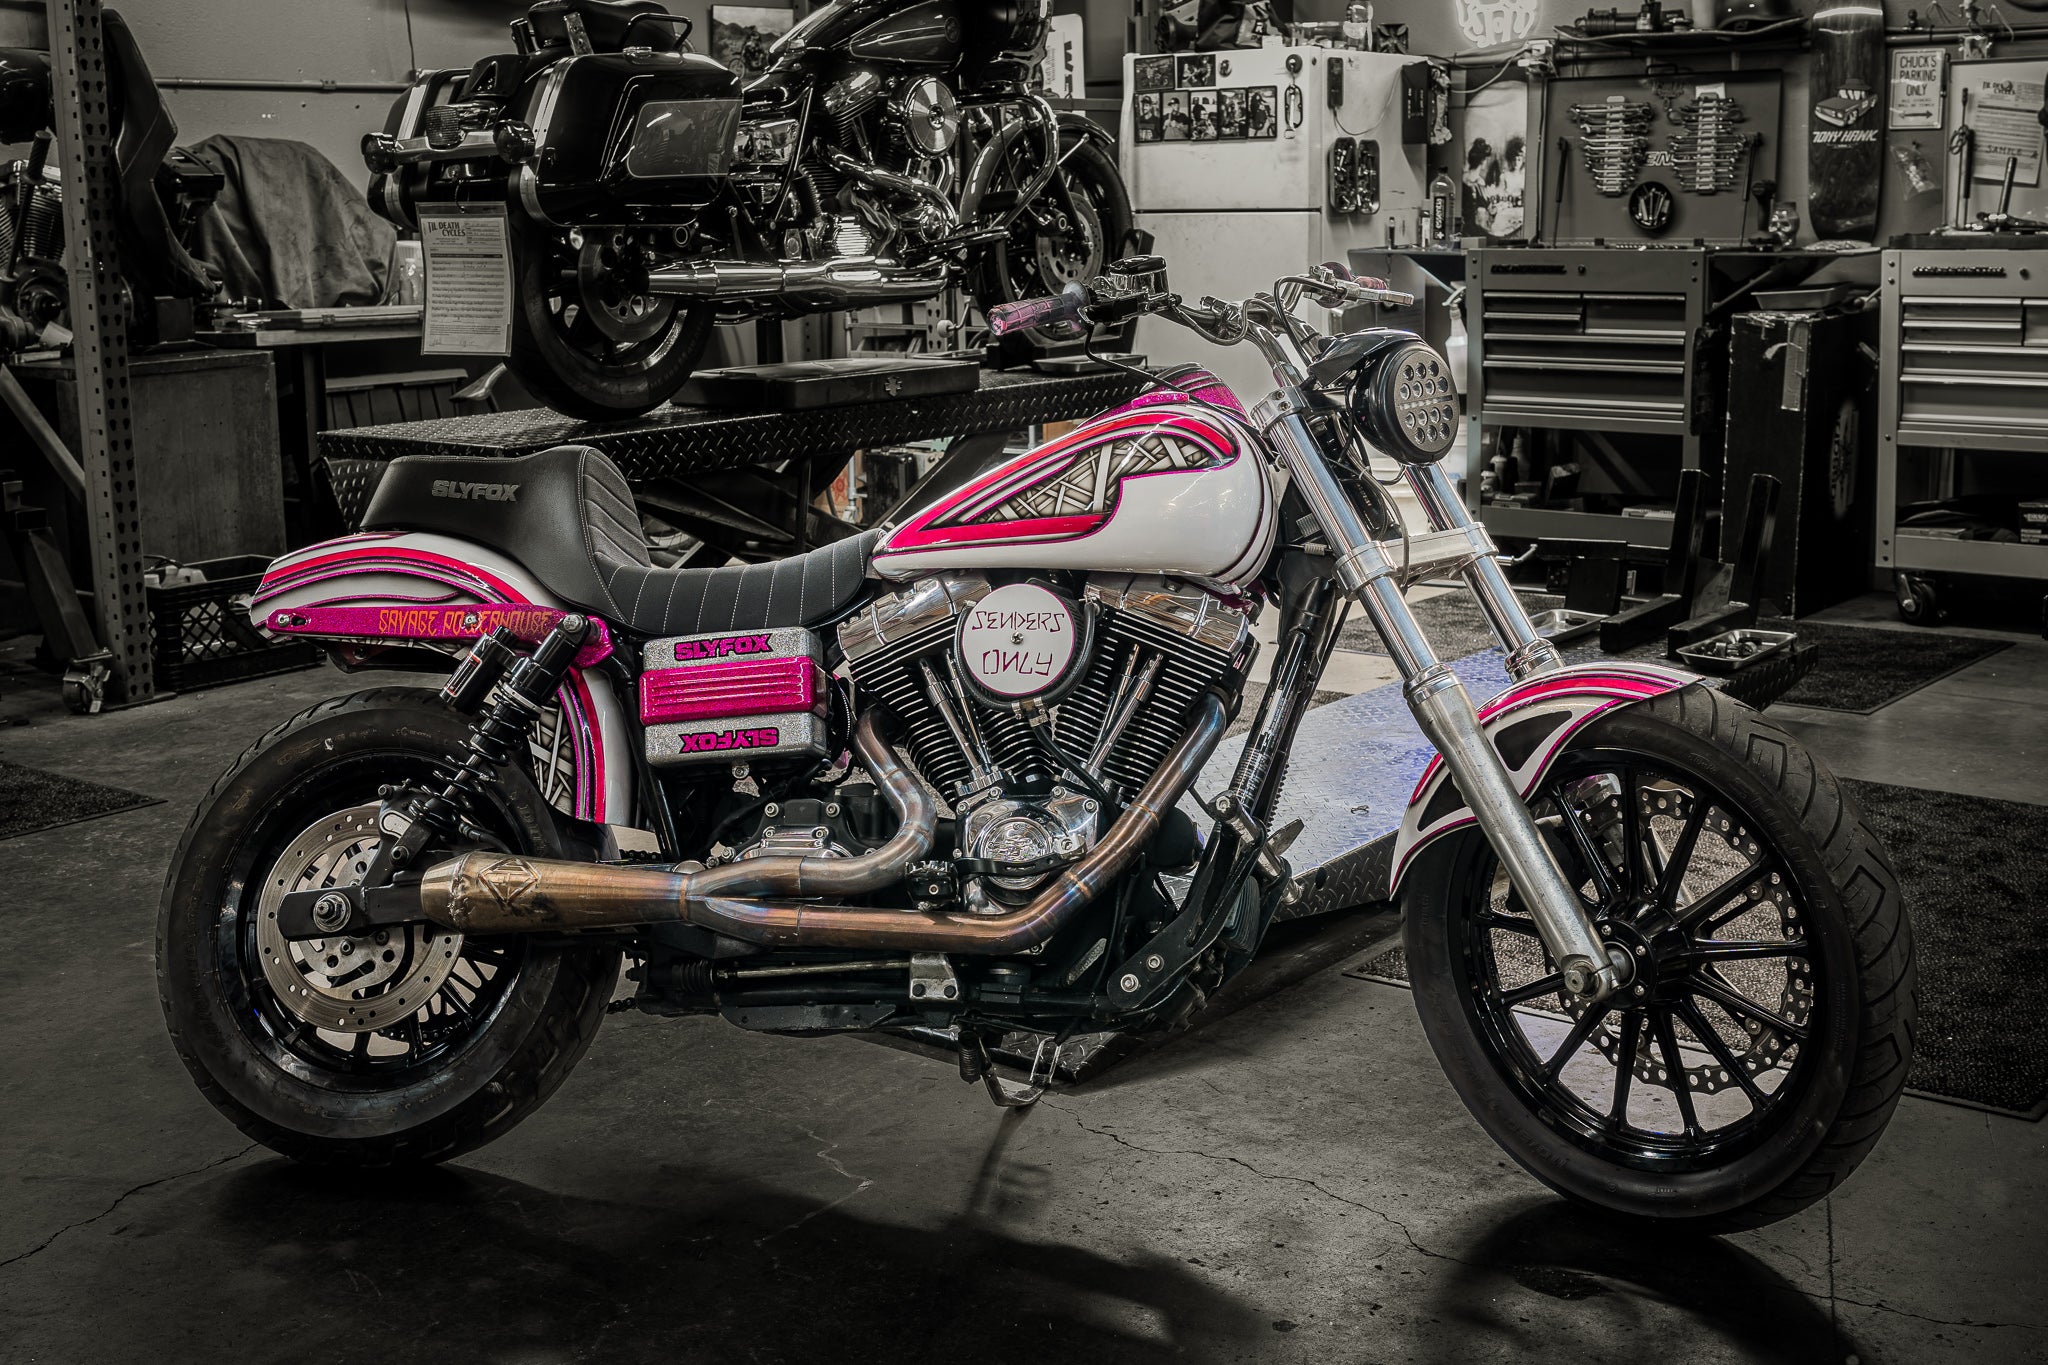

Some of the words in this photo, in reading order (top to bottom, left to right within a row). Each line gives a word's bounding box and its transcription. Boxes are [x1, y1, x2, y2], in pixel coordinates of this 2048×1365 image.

[1900, 69, 1937, 81] PARKING
[1906, 84, 1928, 96] ONLY
[1812, 131, 1842, 143] TONY
[1840, 130, 1878, 142] HAWK
[439, 221, 460, 230] DEATH
[442, 229, 466, 237] CYCLES
[431, 479, 522, 502] SLYFOX
[379, 609, 439, 636] SAVAGE
[972, 611, 1065, 633] SENDERS
[674, 633, 774, 661] SLYFOX
[982, 649, 1053, 677] ONLY
[678, 727, 780, 754] SLYFOX
